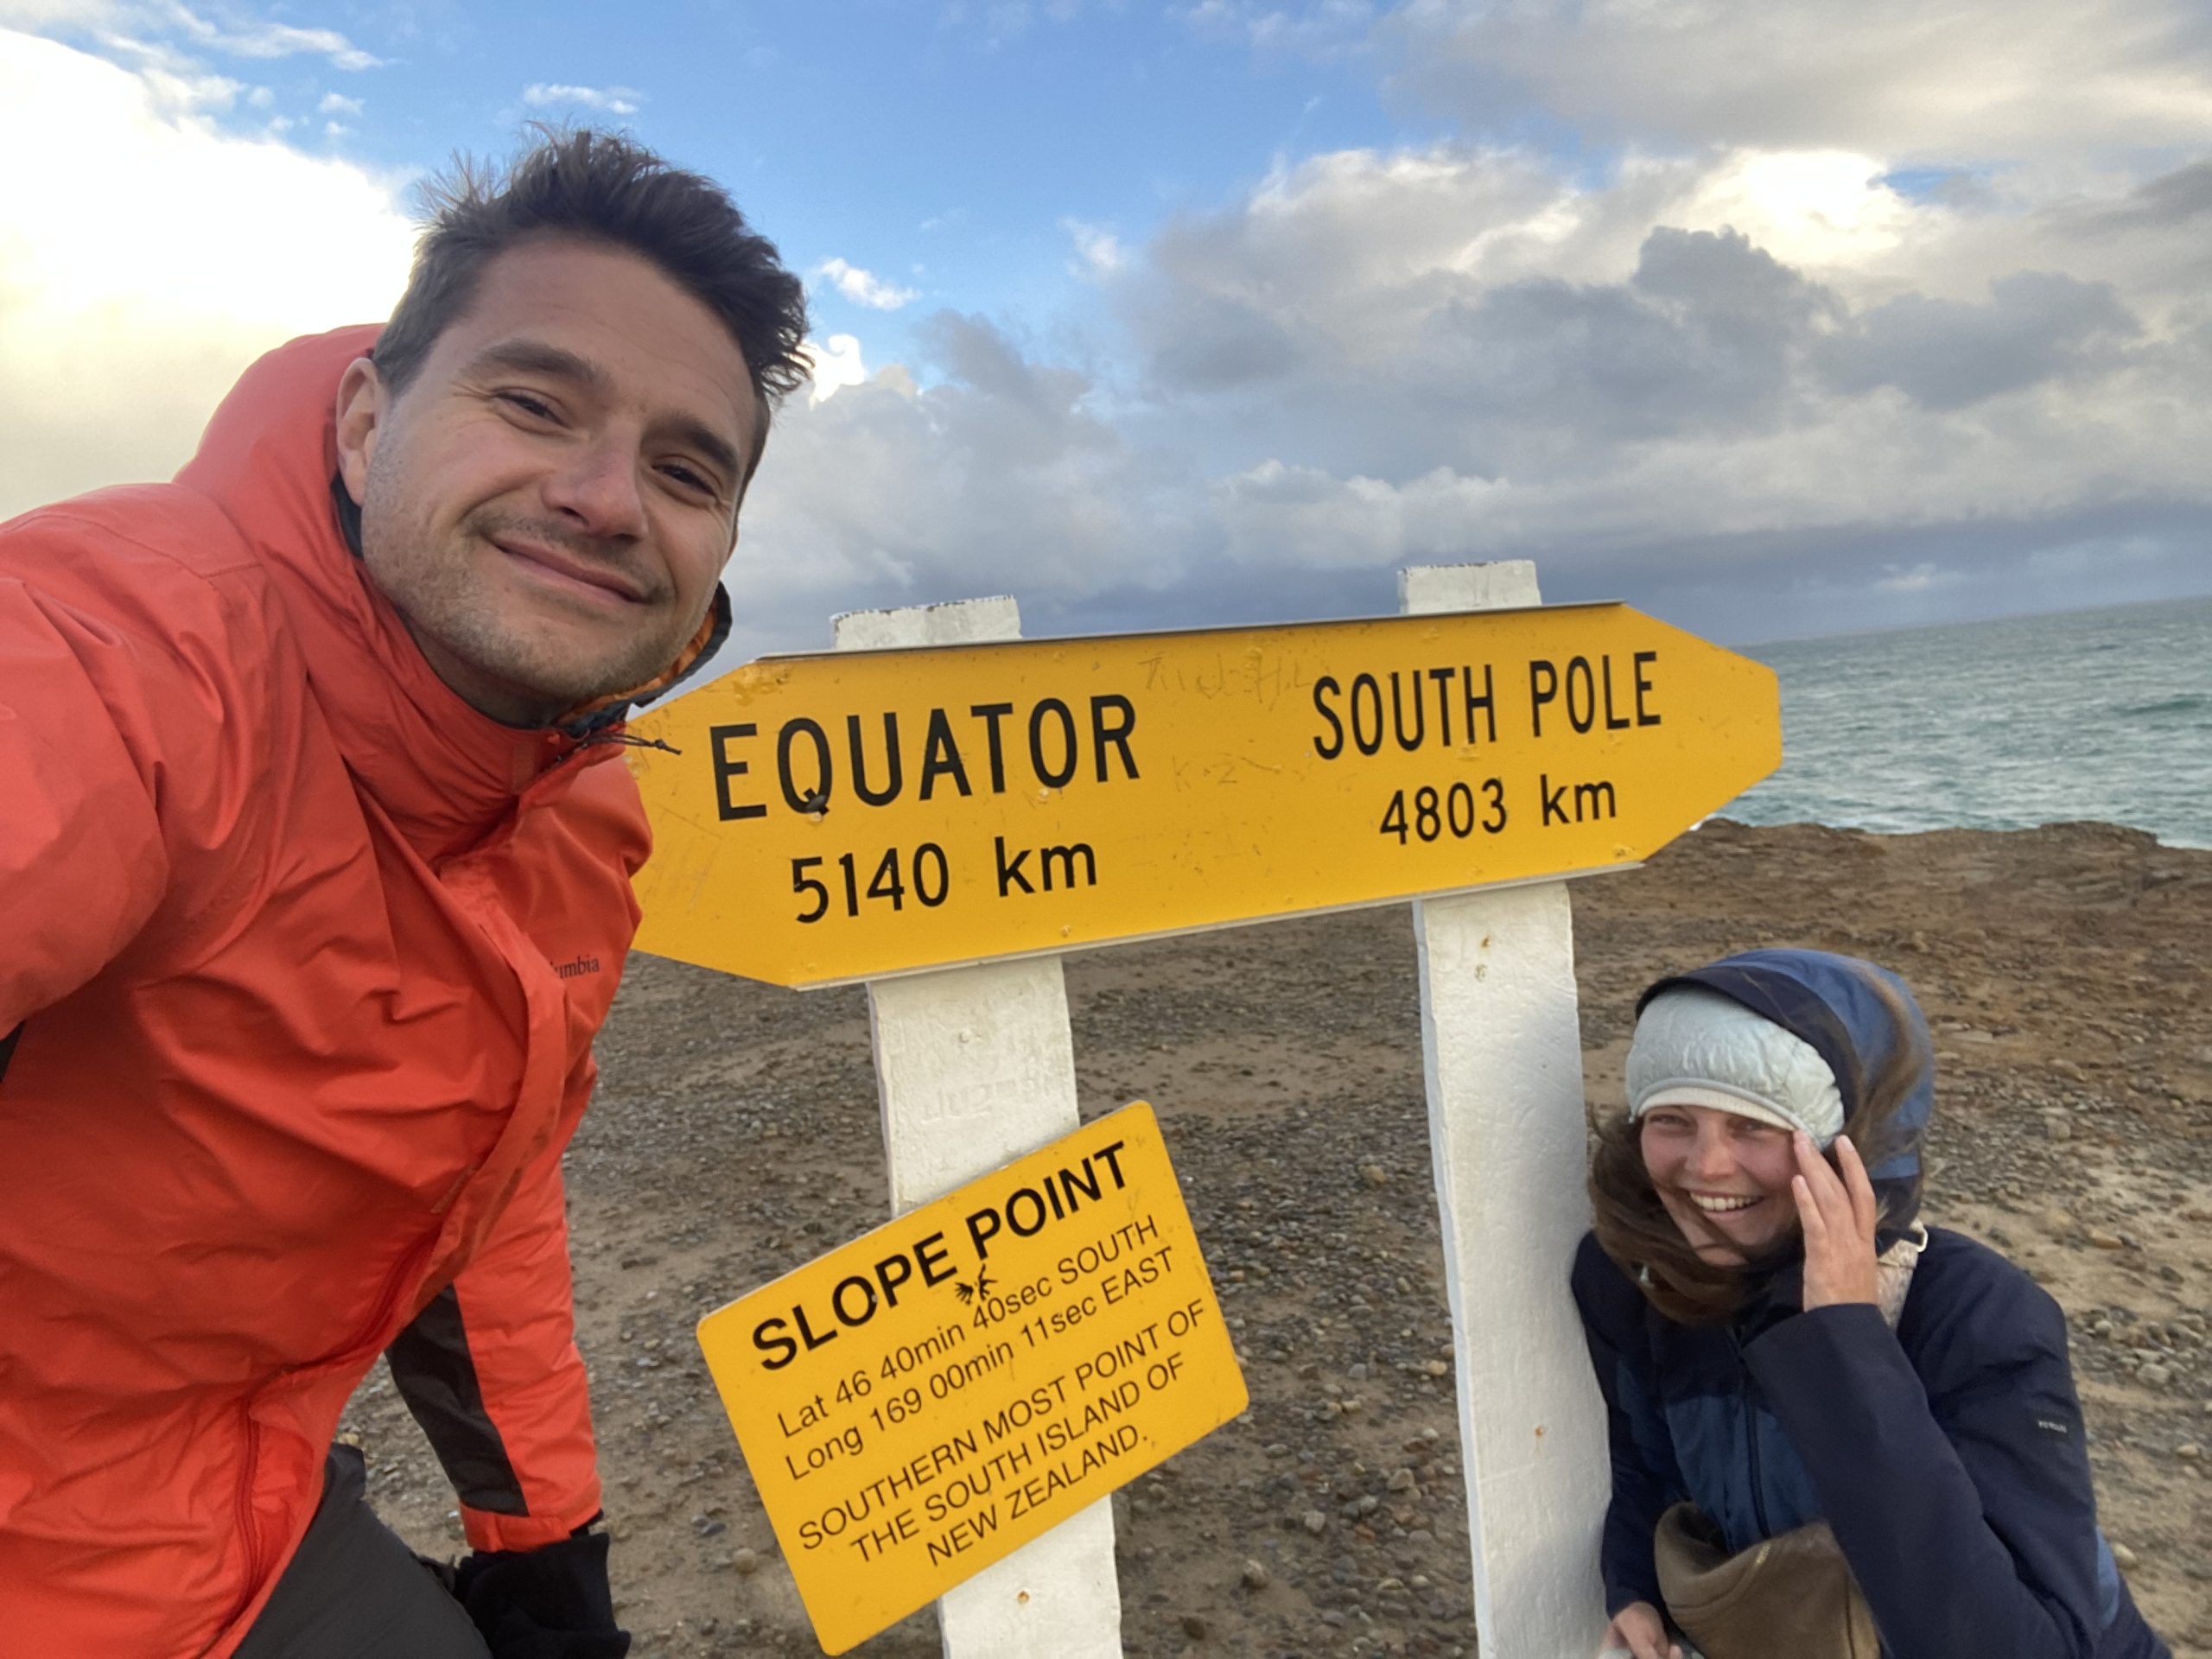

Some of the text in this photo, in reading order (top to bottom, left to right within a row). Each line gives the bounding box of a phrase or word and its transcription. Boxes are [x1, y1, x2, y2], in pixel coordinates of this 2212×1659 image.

[710, 695, 1140, 821] EQUATOR
[1313, 662, 1497, 760] SOUTH
[1529, 651, 1662, 737] POLE
[791, 836, 1096, 924] 5140 km
[1380, 774, 1617, 844] 4803 km
[752, 1140, 1126, 1371] SLOPE POINT
[777, 1214, 1159, 1439] Lat 46 40min 40sec SOUTH
[785, 1245, 1172, 1480] Long 169 00min 11sec EAST
[798, 1299, 1204, 1550] SOUTHERN MOST POINT OF
[849, 1351, 1183, 1562] THE SOUTH ISLAND OF
[926, 1424, 1147, 1567] NEW ZEALAND.
